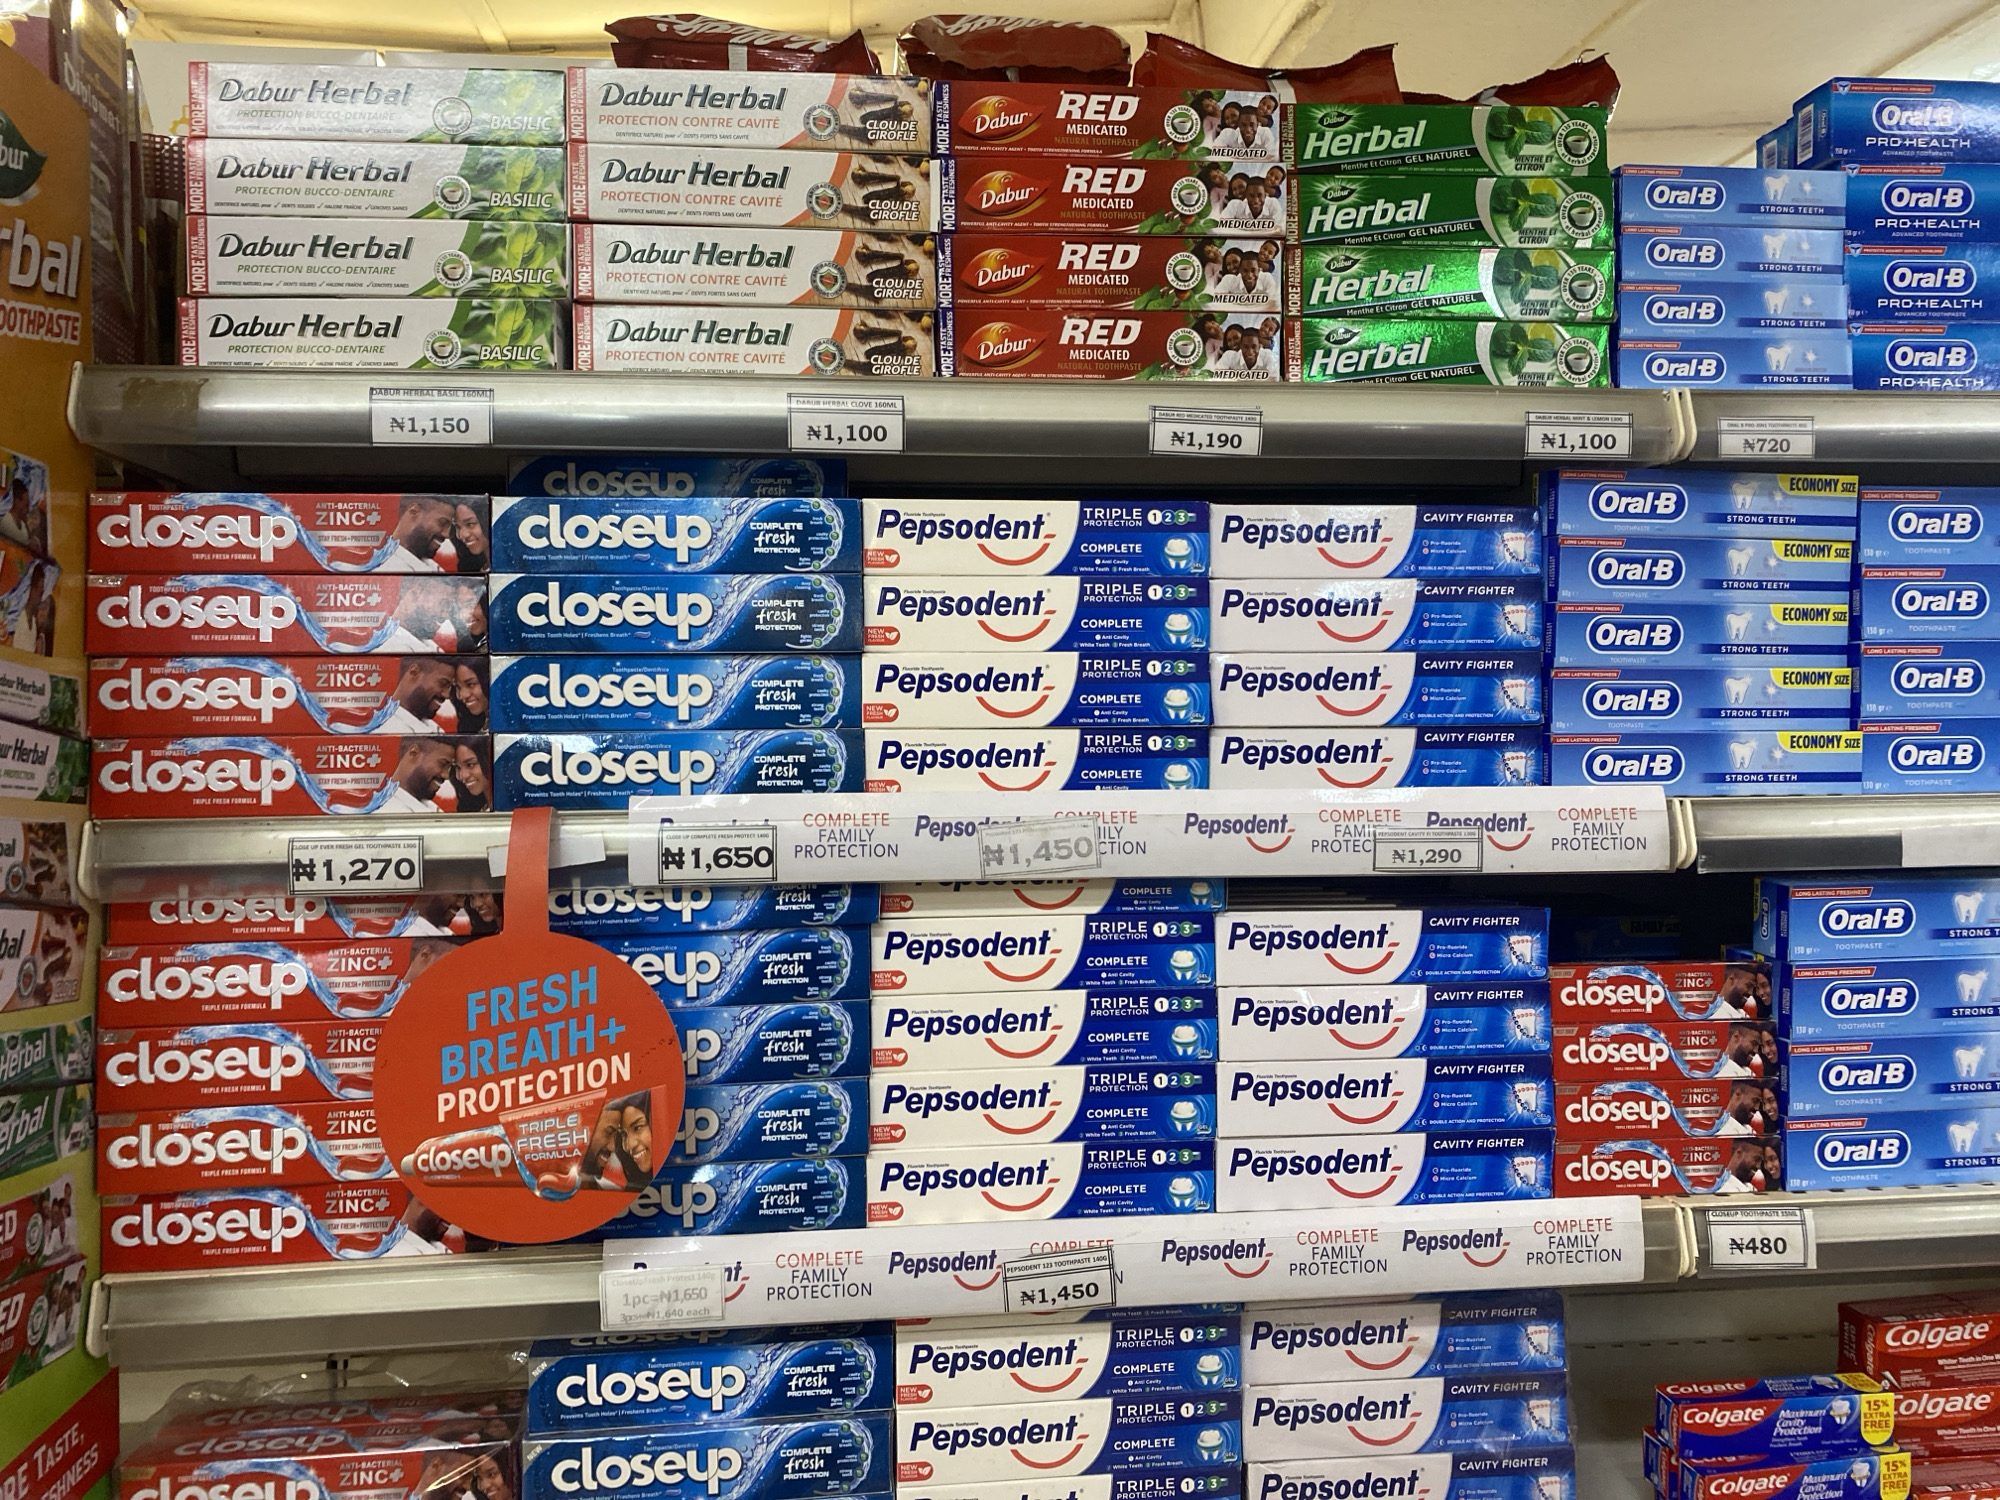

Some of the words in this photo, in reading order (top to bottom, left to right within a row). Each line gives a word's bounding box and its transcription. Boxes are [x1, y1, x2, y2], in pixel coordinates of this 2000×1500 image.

[1055, 93, 1140, 122] RED
[975, 112, 1028, 134] Dabur
[1323, 114, 1346, 125] Dabur
[937, 122, 950, 154] MORE
[1066, 124, 1127, 136] MEDICATED
[1303, 119, 1427, 160] Herbal
[1054, 136, 1091, 145] NATURAL
[1094, 137, 1139, 146] TOOTHPASTE
[1210, 148, 1267, 158] MEDICATED
[1405, 154, 1423, 164] GEL
[1425, 149, 1471, 162] NATUREL
[216, 156, 302, 181] Dabur
[305, 156, 412, 183] Herbal
[602, 158, 684, 183] Dabur
[687, 160, 791, 189] Herbal
[1340, 162, 1368, 171] Menthe
[1379, 158, 1401, 168] Citron
[235, 186, 301, 196] PROTECTION
[304, 187, 395, 198] BUCCO-DENTAIRE
[489, 192, 553, 208] BASILIC
[601, 192, 669, 202] PROTECTION
[699, 194, 737, 204] CONTRE
[740, 194, 783, 207] CAVITÉ
[1653, 186, 1716, 205] Oral-B
[1891, 187, 1964, 208] Oral-B
[868, 200, 900, 210] CLOU
[902, 201, 919, 211] DE
[1760, 206, 1794, 214] STRONG
[869, 210, 919, 221] GIROFLE
[389, 417, 470, 436] ₦1,150
[807, 424, 888, 445] ₦1,100
[1170, 431, 1242, 450] ₦1,190
[1541, 432, 1617, 452] ₦1,100
[1743, 438, 1791, 453] ₦720
[1789, 477, 1839, 492] ECONOMY
[1841, 482, 1856, 492] SIZE
[1599, 490, 1677, 514] Oral-B
[877, 509, 1045, 545] Pepsodent
[1423, 513, 1464, 523] CAVITY
[1467, 513, 1514, 523] FIGHTER
[1726, 515, 1764, 524] STRONG
[1767, 515, 1796, 524] TEETH
[97, 504, 297, 563] closeup
[1221, 515, 1382, 549] Pepsodent
[751, 599, 804, 607] COMPLETE
[1901, 590, 1979, 611] Oral-B
[517, 582, 714, 641] closeup
[756, 608, 797, 623] fresh
[98, 668, 297, 723] closeup
[802, 812, 890, 827] COMPLETE
[1184, 812, 1288, 838] Pepsodent
[817, 827, 875, 843] FAMILY
[661, 846, 774, 873] ₦1,650
[794, 843, 899, 859] PROTECTION
[984, 836, 1094, 867] ₦1,450
[1392, 848, 1462, 867] ₦1,290
[291, 857, 416, 886] ₦1,270
[1828, 908, 1905, 931] Oral-B
[467, 965, 597, 1032] FRESH
[440, 1014, 626, 1085] BREATH+
[1563, 1038, 1669, 1071] closeup
[437, 1052, 631, 1123] PROTECTION
[1089, 1073, 1148, 1085] TRIPLE
[1089, 1084, 1148, 1092] PROTECTION
[882, 1082, 1050, 1119] Pepsodent
[1087, 1108, 1148, 1118] COMPLETE
[519, 1113, 579, 1135] TRIPLE
[516, 1128, 588, 1152] FRESH
[417, 1142, 512, 1177] closeup
[525, 1148, 581, 1162] FORMULA
[1711, 1210, 1739, 1218] CLOSEUP
[1740, 1210, 1780, 1218] TOOTHPASTE
[111, 1204, 307, 1253] closeup
[1532, 1218, 1613, 1234] COMPLETE
[1402, 1227, 1503, 1255] Pepsodent
[1548, 1233, 1600, 1250] FAMILY
[1729, 1237, 1788, 1255] ₦480
[1006, 1263, 1042, 1273] PEPSODENT
[1054, 1257, 1091, 1268] TOOTHPASTE
[1525, 1247, 1623, 1266] PROTECTION
[1020, 1282, 1099, 1306] ₦1,450
[1885, 1321, 1990, 1349] Colgate
[909, 1339, 1077, 1379] Pepsodent
[556, 1363, 746, 1412] closeup
[1779, 1408, 1826, 1418] Maximum
[1866, 1400, 1889, 1411] 15%
[1683, 1407, 1765, 1428] Colgate
[1776, 1418, 1806, 1428] Cavity
[1864, 1419, 1891, 1429] FREE
[1773, 1426, 1822, 1436] Protection
